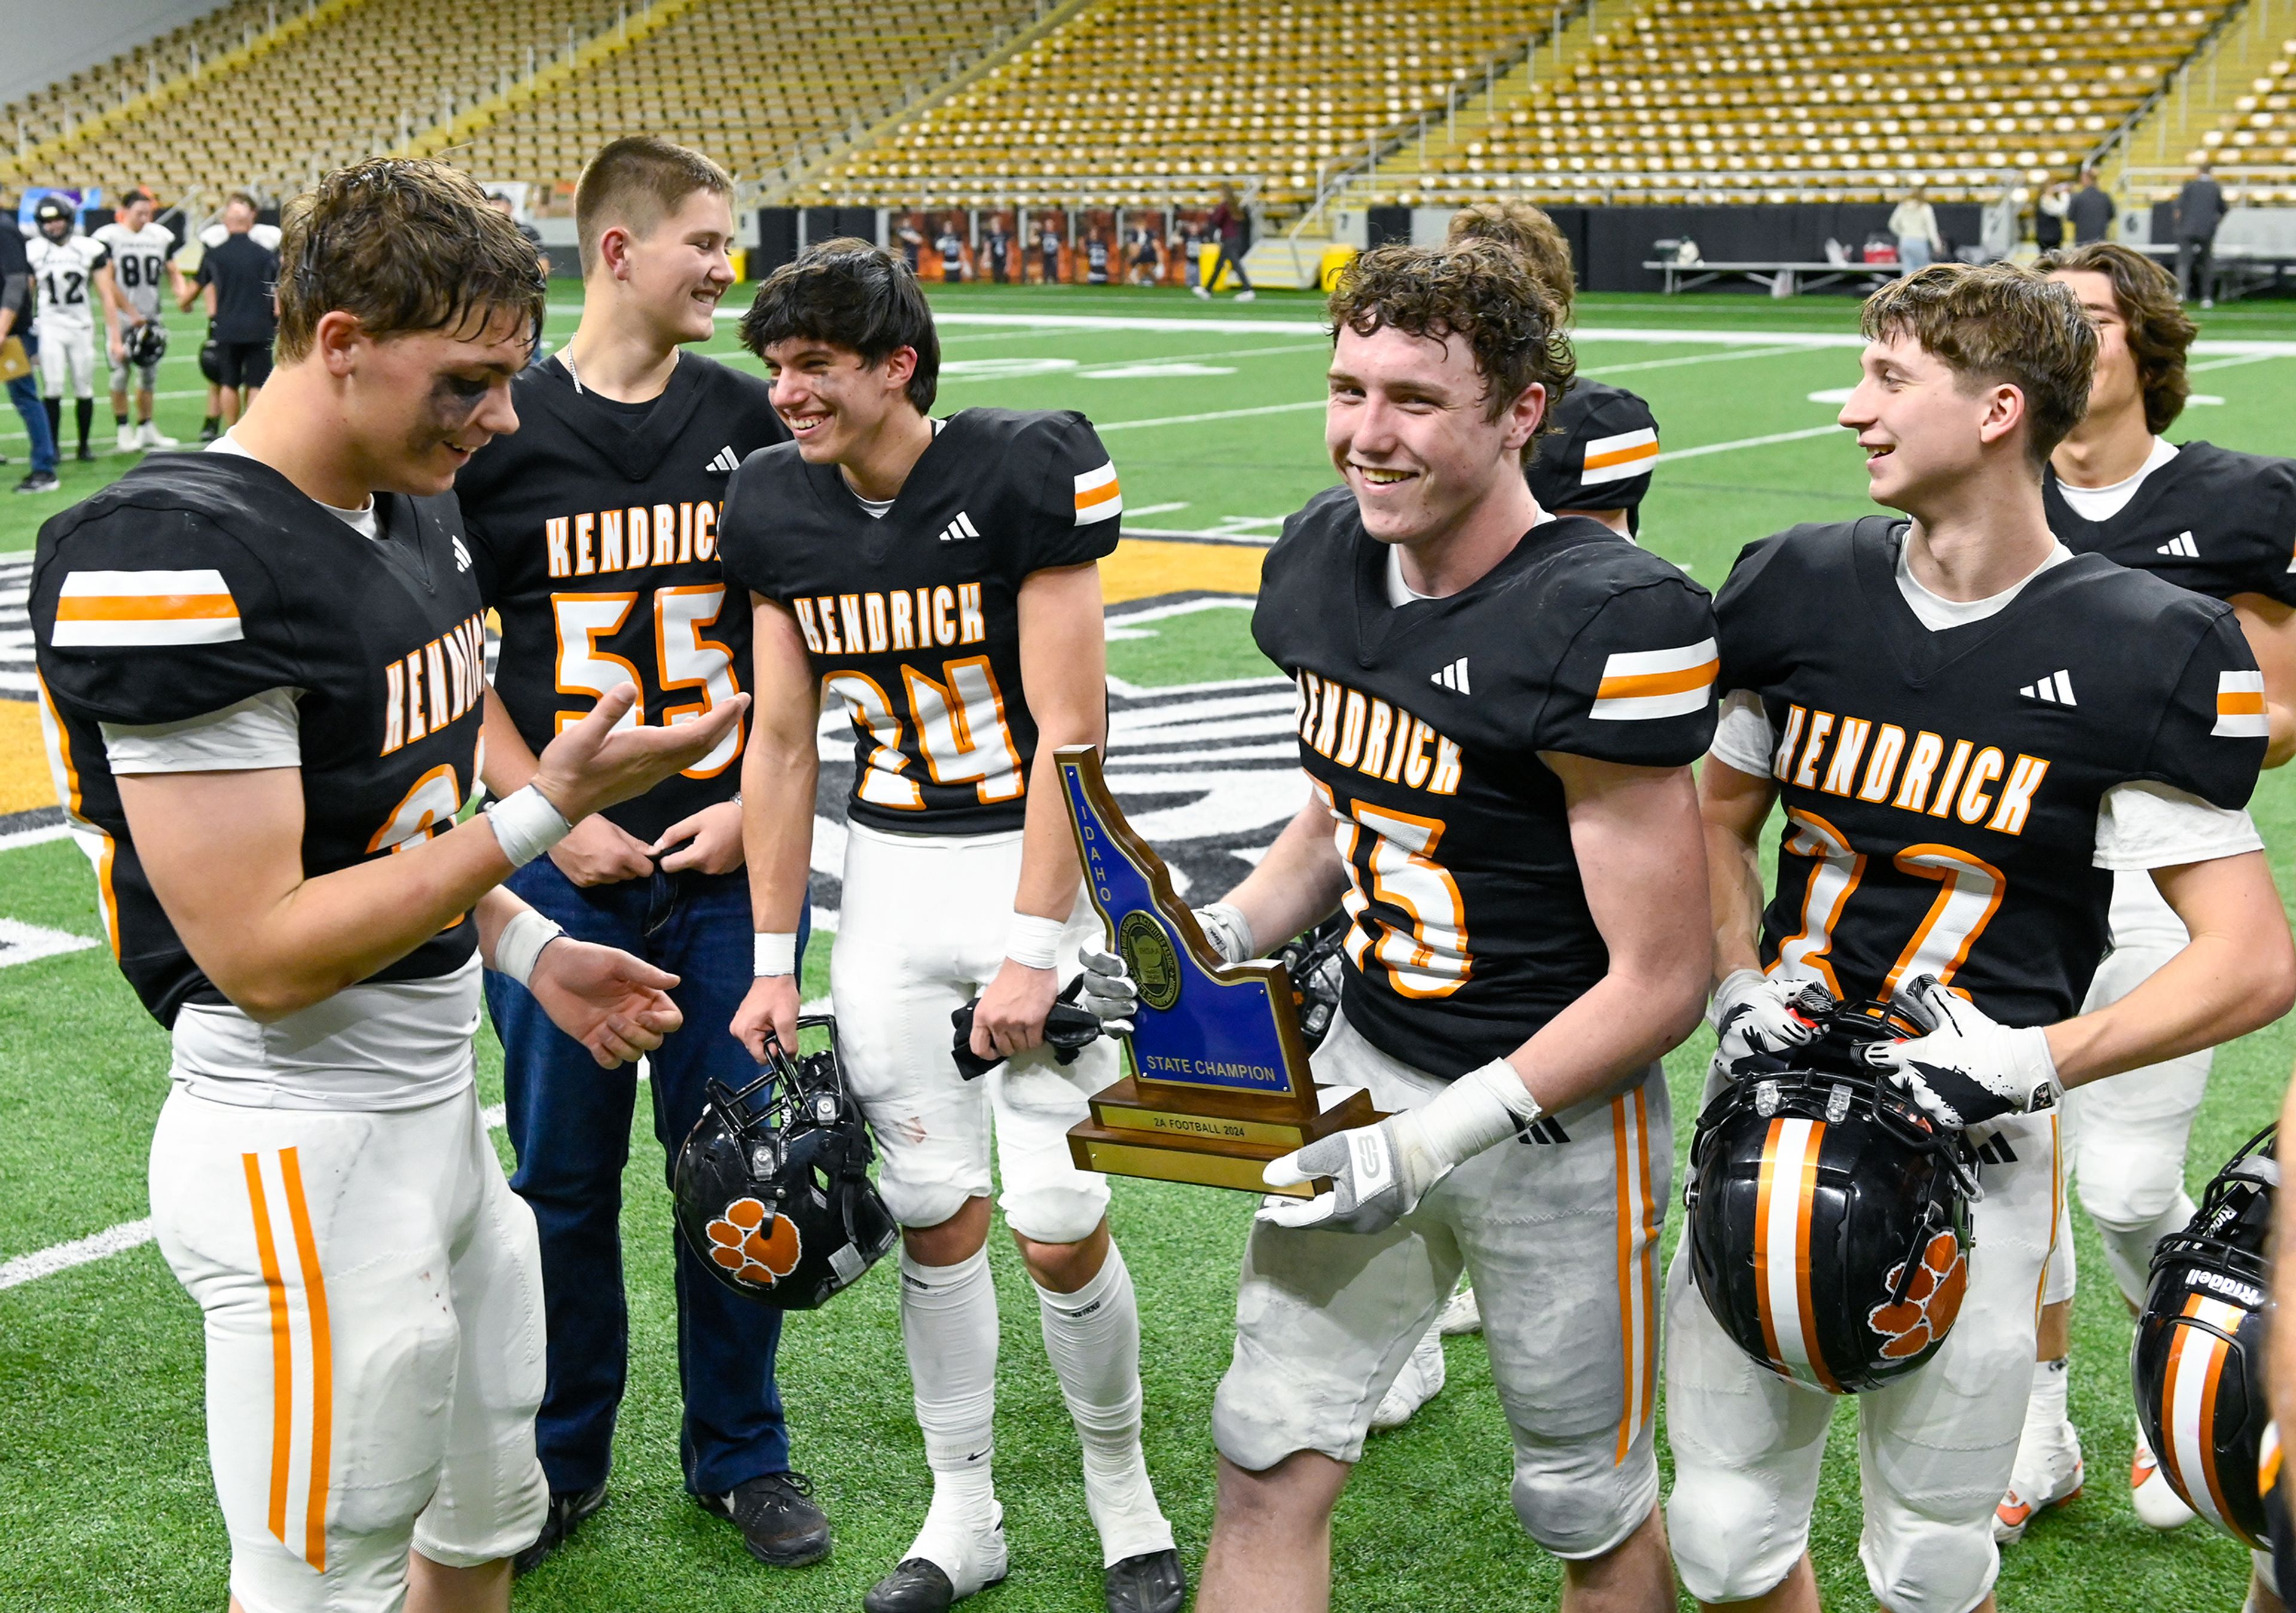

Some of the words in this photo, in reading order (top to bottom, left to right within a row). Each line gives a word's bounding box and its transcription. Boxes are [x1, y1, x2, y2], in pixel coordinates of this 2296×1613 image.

[45, 271, 84, 304] 12
[122, 255, 161, 287] 80
[546, 501, 722, 578] KENDRIC
[793, 582, 985, 654] KENDRICK
[379, 608, 486, 758] KENDRIC
[550, 584, 744, 779] 55
[822, 654, 1024, 811] 24
[1773, 704, 2050, 836] KENDRICK
[1081, 806, 1112, 901] IDAHO
[1146, 1055, 1192, 1074] STATE
[1195, 1060, 1276, 1082] CHAMPION
[1154, 1117, 1167, 1128] 2A
[1169, 1119, 1220, 1135] FOOTBALL
[1223, 1126, 1245, 1137] 2024
[2185, 1268, 2260, 1306] Riddell
